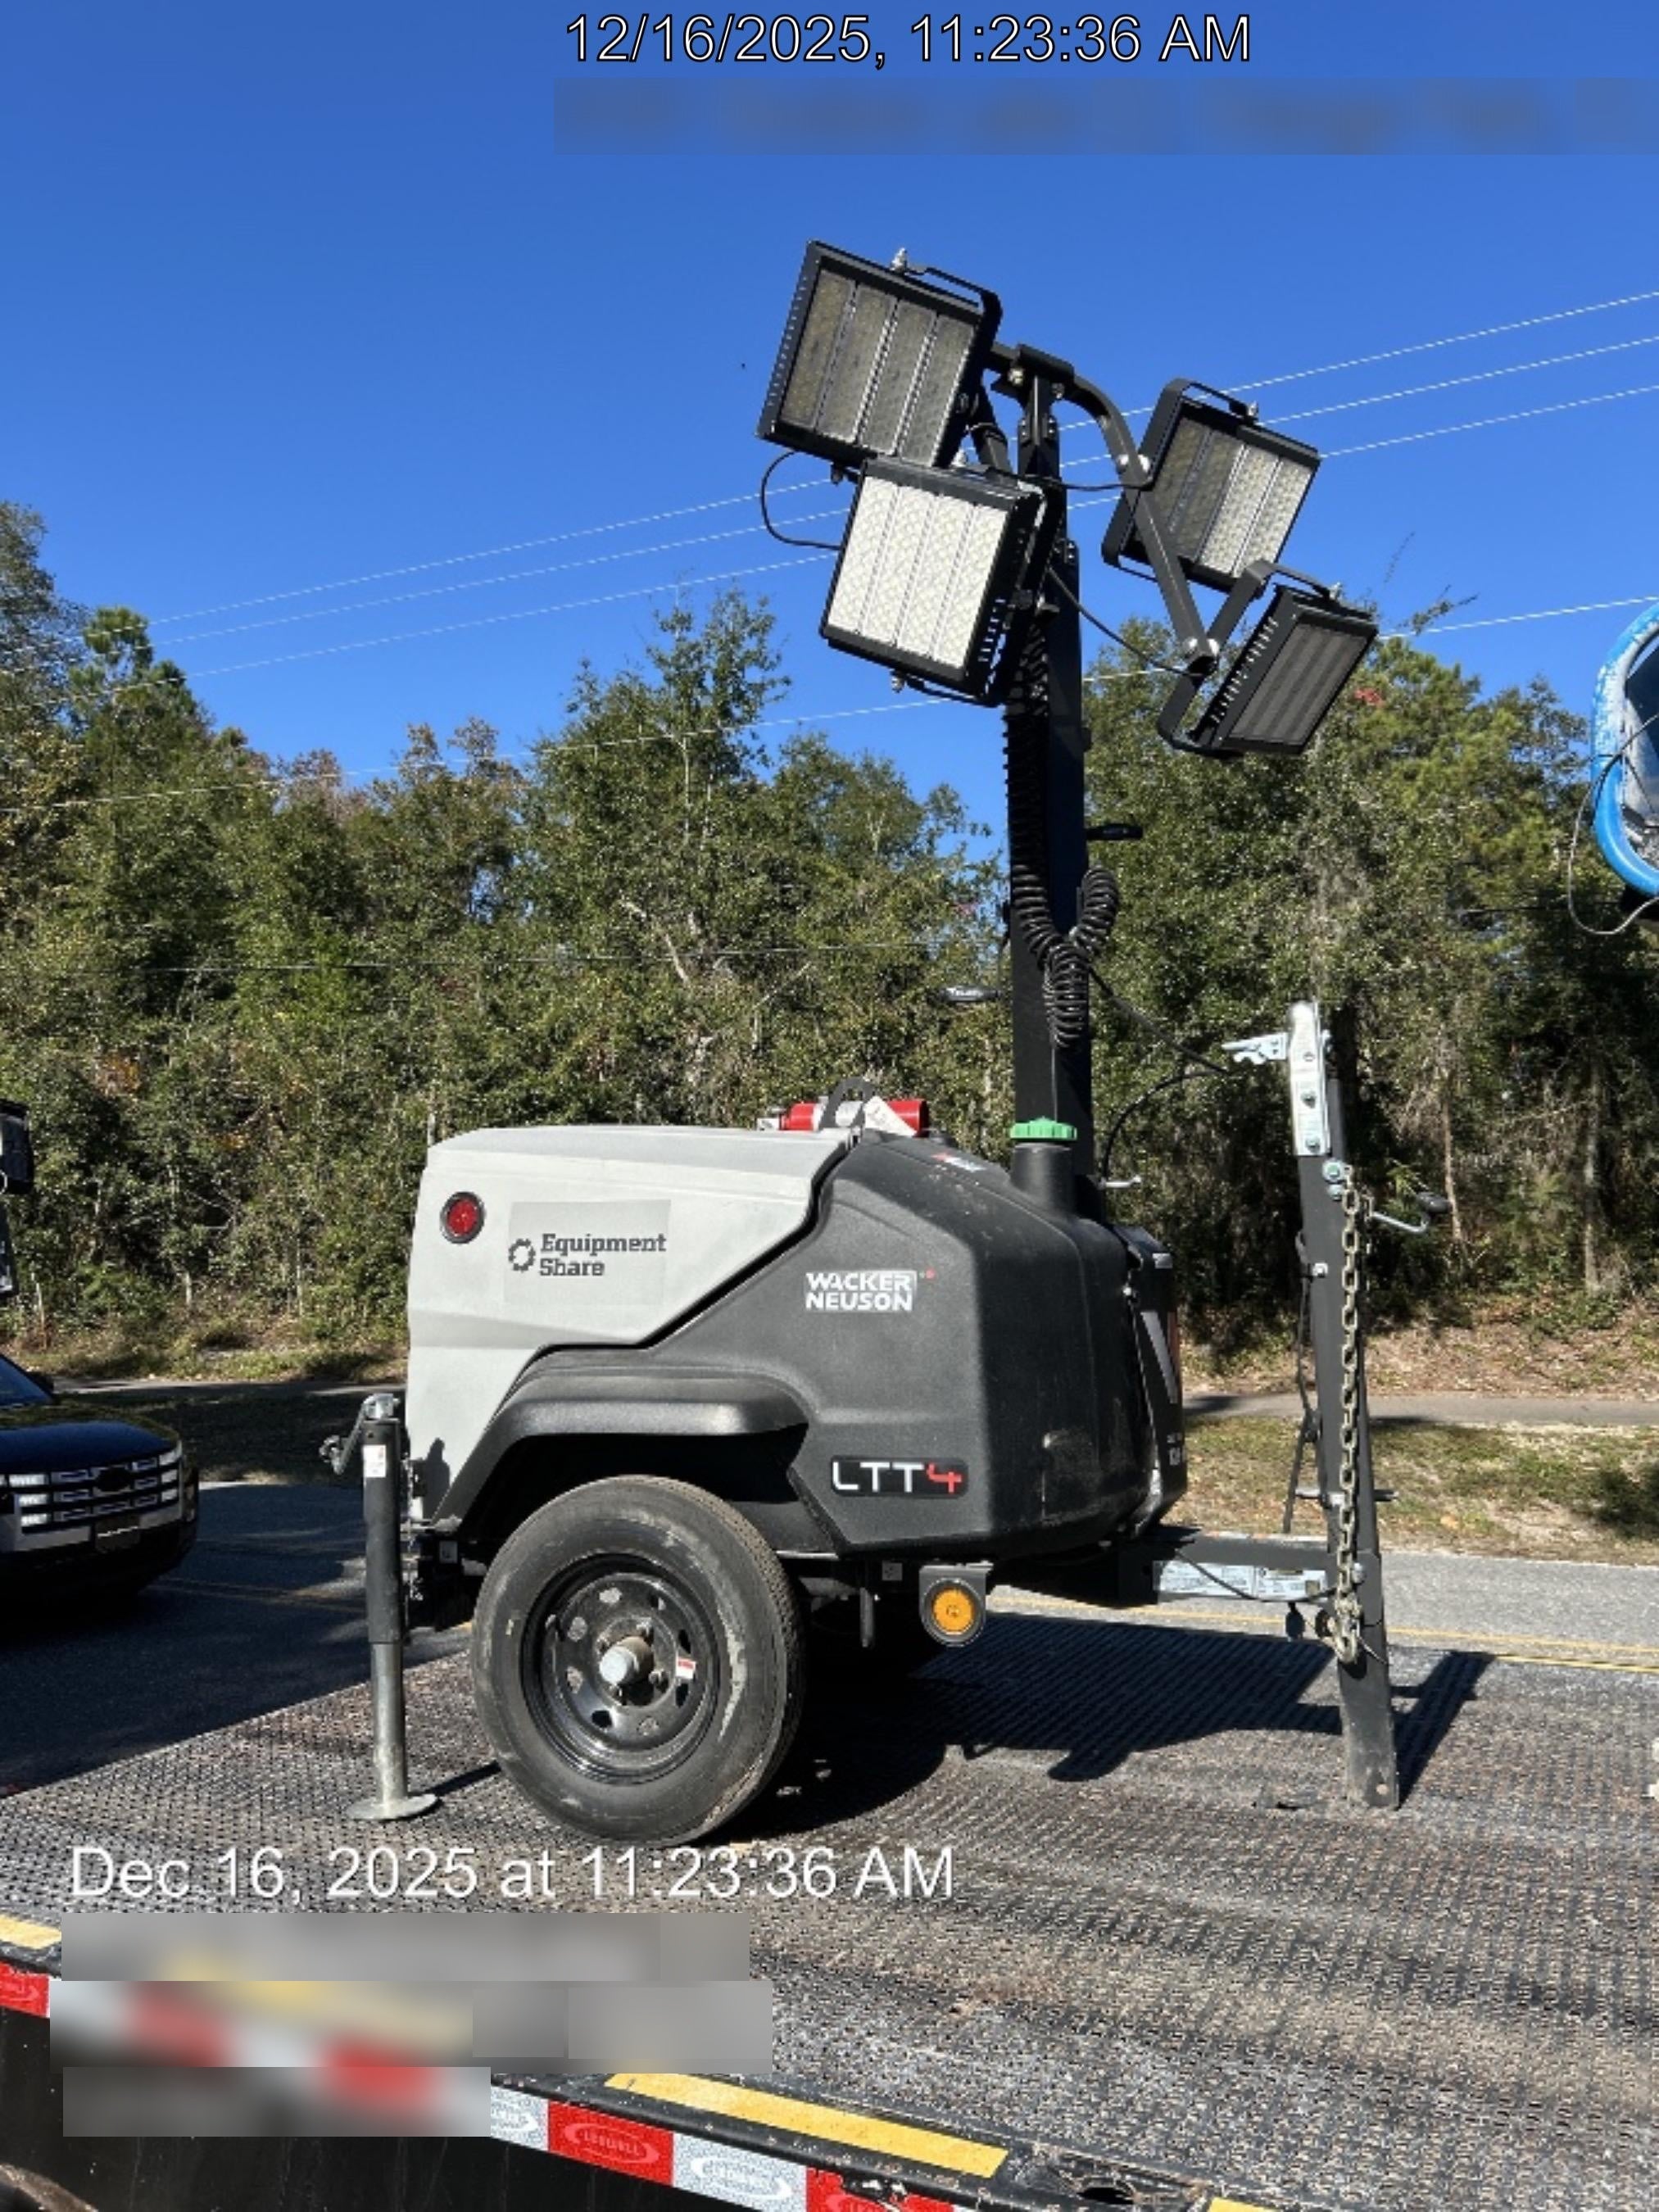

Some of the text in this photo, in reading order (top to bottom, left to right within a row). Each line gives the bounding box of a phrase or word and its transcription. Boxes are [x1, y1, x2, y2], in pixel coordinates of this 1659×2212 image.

[541, 1233, 667, 1257] Equipment
[539, 1258, 605, 1276] Share
[805, 1271, 913, 1292] WACKER
[805, 1291, 913, 1312] NEUSON
[832, 1461, 962, 1494] LTT4
